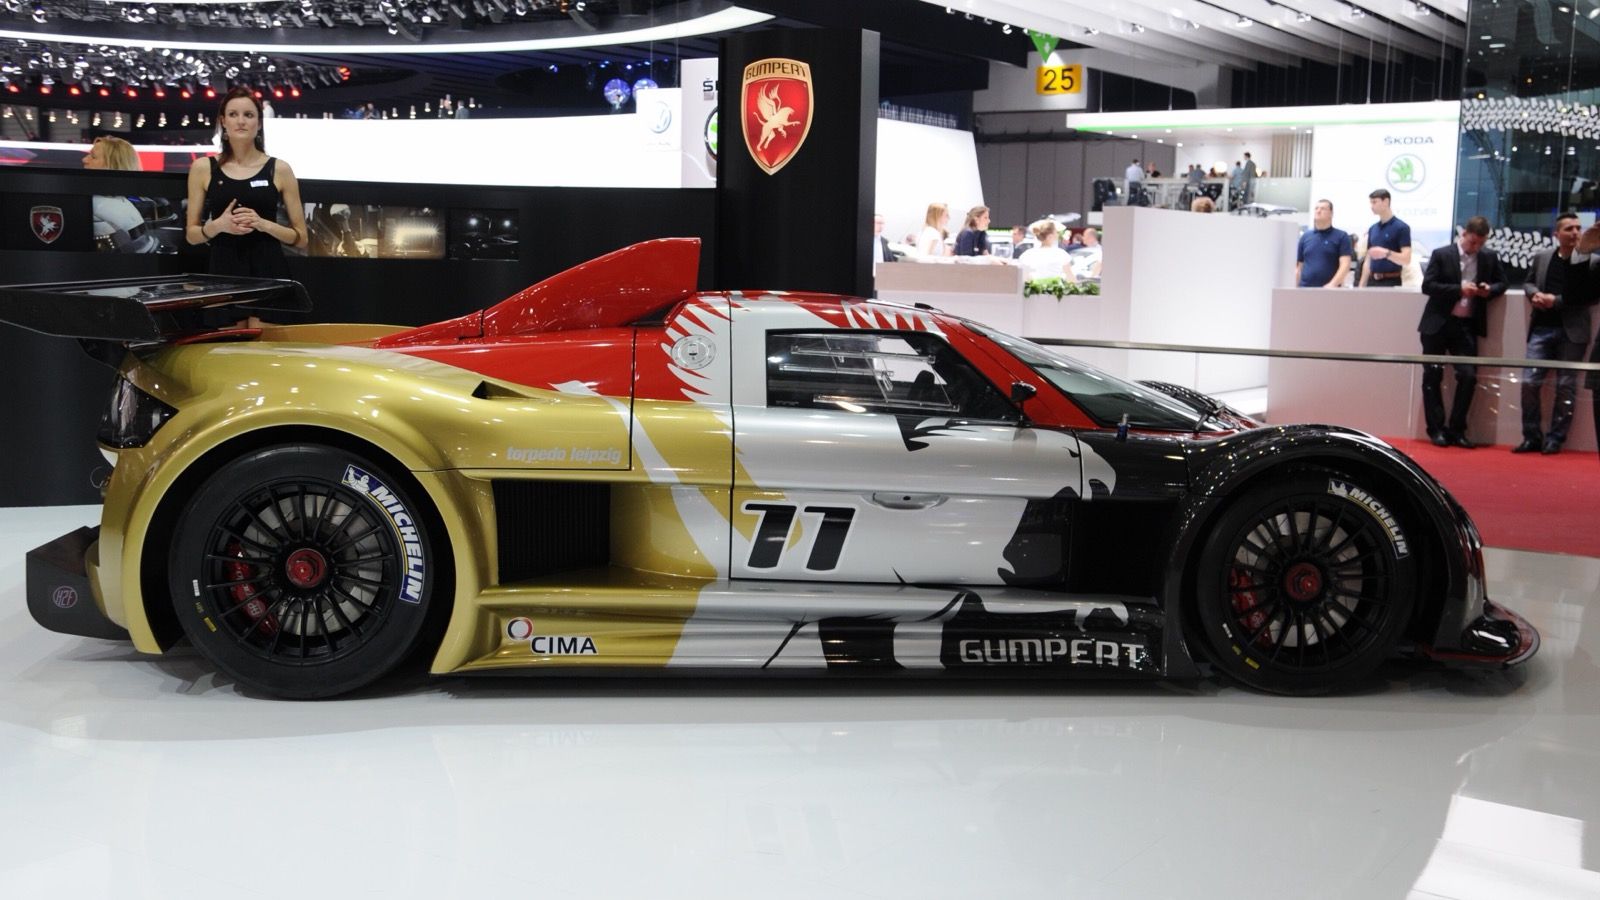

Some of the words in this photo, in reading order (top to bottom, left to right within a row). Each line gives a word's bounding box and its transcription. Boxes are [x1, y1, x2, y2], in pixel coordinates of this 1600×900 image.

[745, 62, 806, 80] GUMPERT
[1043, 67, 1074, 91] 25
[703, 77, 718, 92] Š
[506, 446, 567, 463] torpedo
[570, 446, 622, 464] leipzig
[1349, 487, 1408, 553] MICHELIN
[371, 485, 423, 600] MICHELIN
[531, 636, 597, 654] CIMA
[959, 639, 1145, 668] GUMPERT
